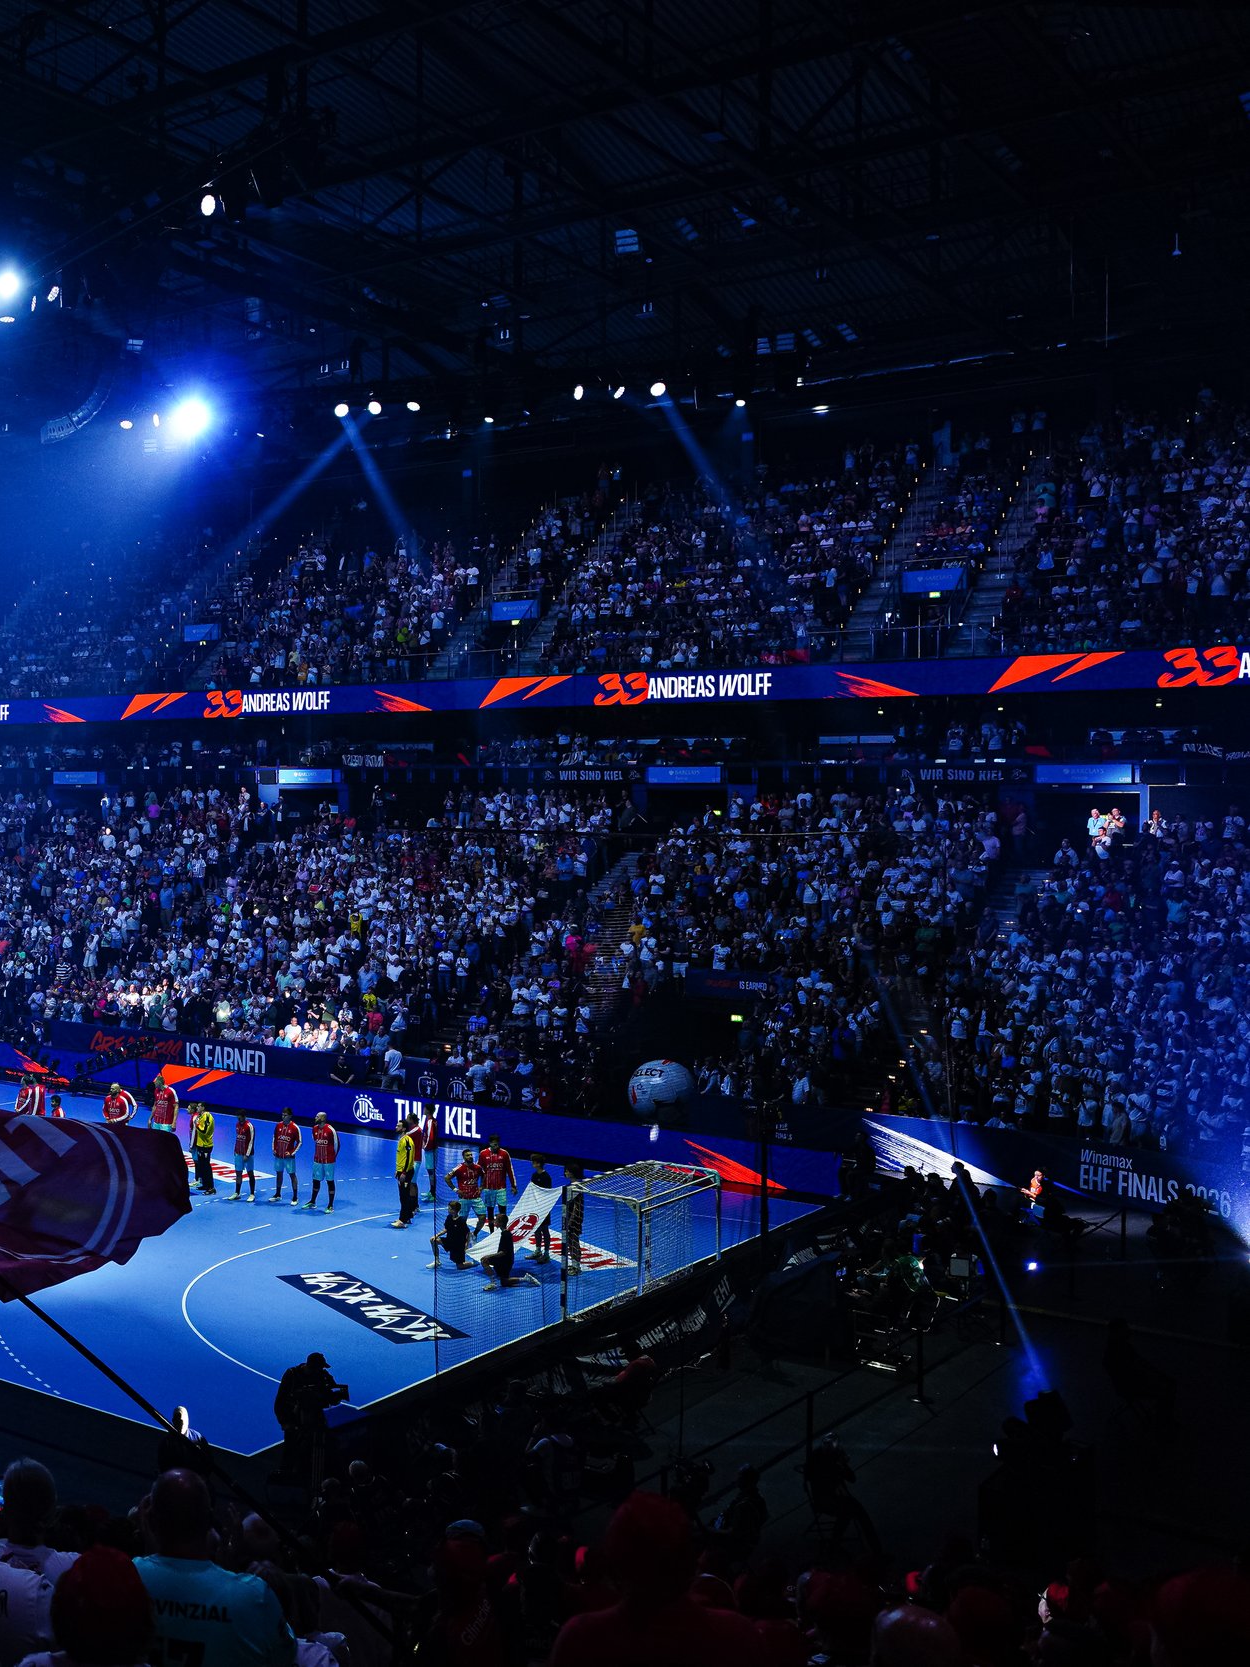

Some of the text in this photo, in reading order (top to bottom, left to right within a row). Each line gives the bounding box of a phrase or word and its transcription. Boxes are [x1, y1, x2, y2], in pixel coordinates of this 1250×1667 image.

[1157, 646, 1240, 687] 33
[203, 690, 330, 718] 33 ANDREAS WOLFF
[594, 672, 772, 706] 33 ANDREAS WOLFF
[559, 770, 624, 781] WIR SIND KIEL
[920, 769, 1004, 781] WIR SIND KIEL
[186, 1042, 200, 1067] IS
[204, 1044, 266, 1075] EARNED
[369, 1111, 385, 1122] KIEL
[444, 1105, 481, 1139] KIEL
[1080, 1149, 1133, 1170] Winamax
[1080, 1164, 1113, 1193] EHF
[1117, 1170, 1180, 1205] FINALS
